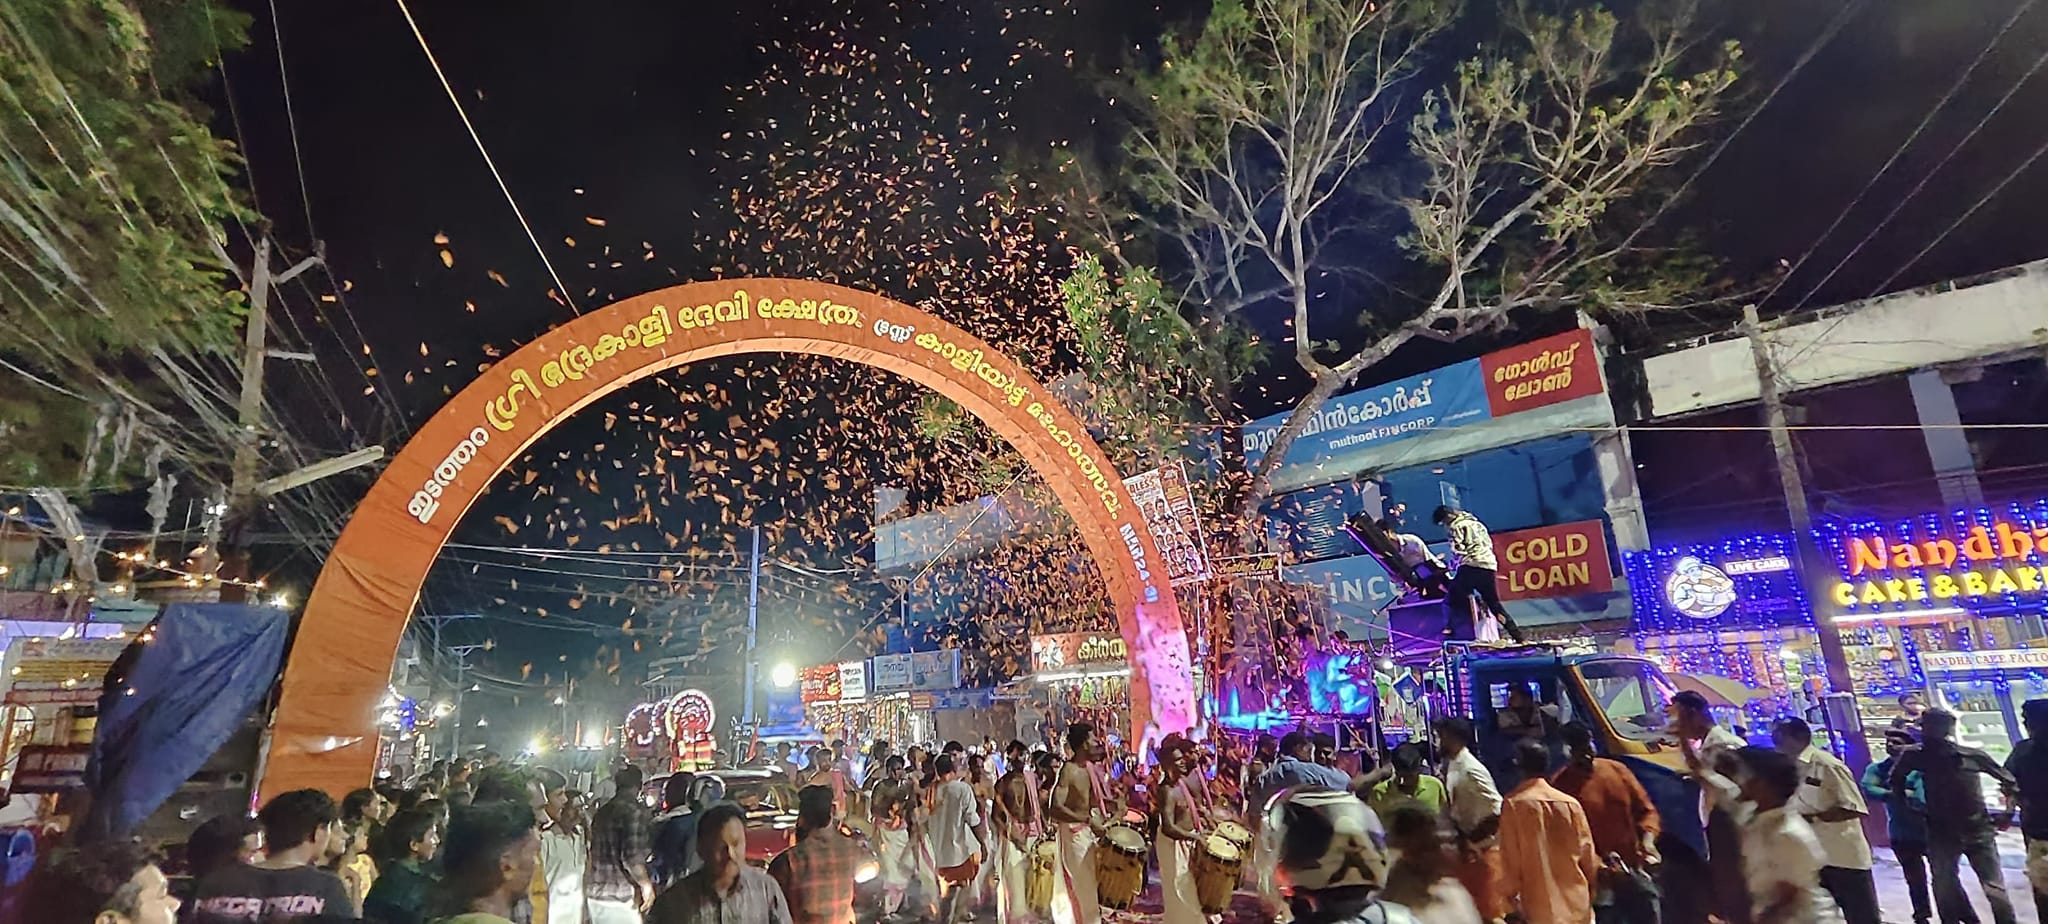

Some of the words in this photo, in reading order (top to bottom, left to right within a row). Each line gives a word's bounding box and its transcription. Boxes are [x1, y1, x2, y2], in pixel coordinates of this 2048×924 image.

[484, 368, 542, 431] ശ്രീ
[678, 289, 749, 329] ദേവി
[1504, 367, 1572, 401] ലോൺ
[1506, 533, 1588, 564] GOLD
[1509, 561, 1589, 592] LOAN
[1835, 578, 1928, 605] CAKE
[1933, 574, 1959, 598] &
